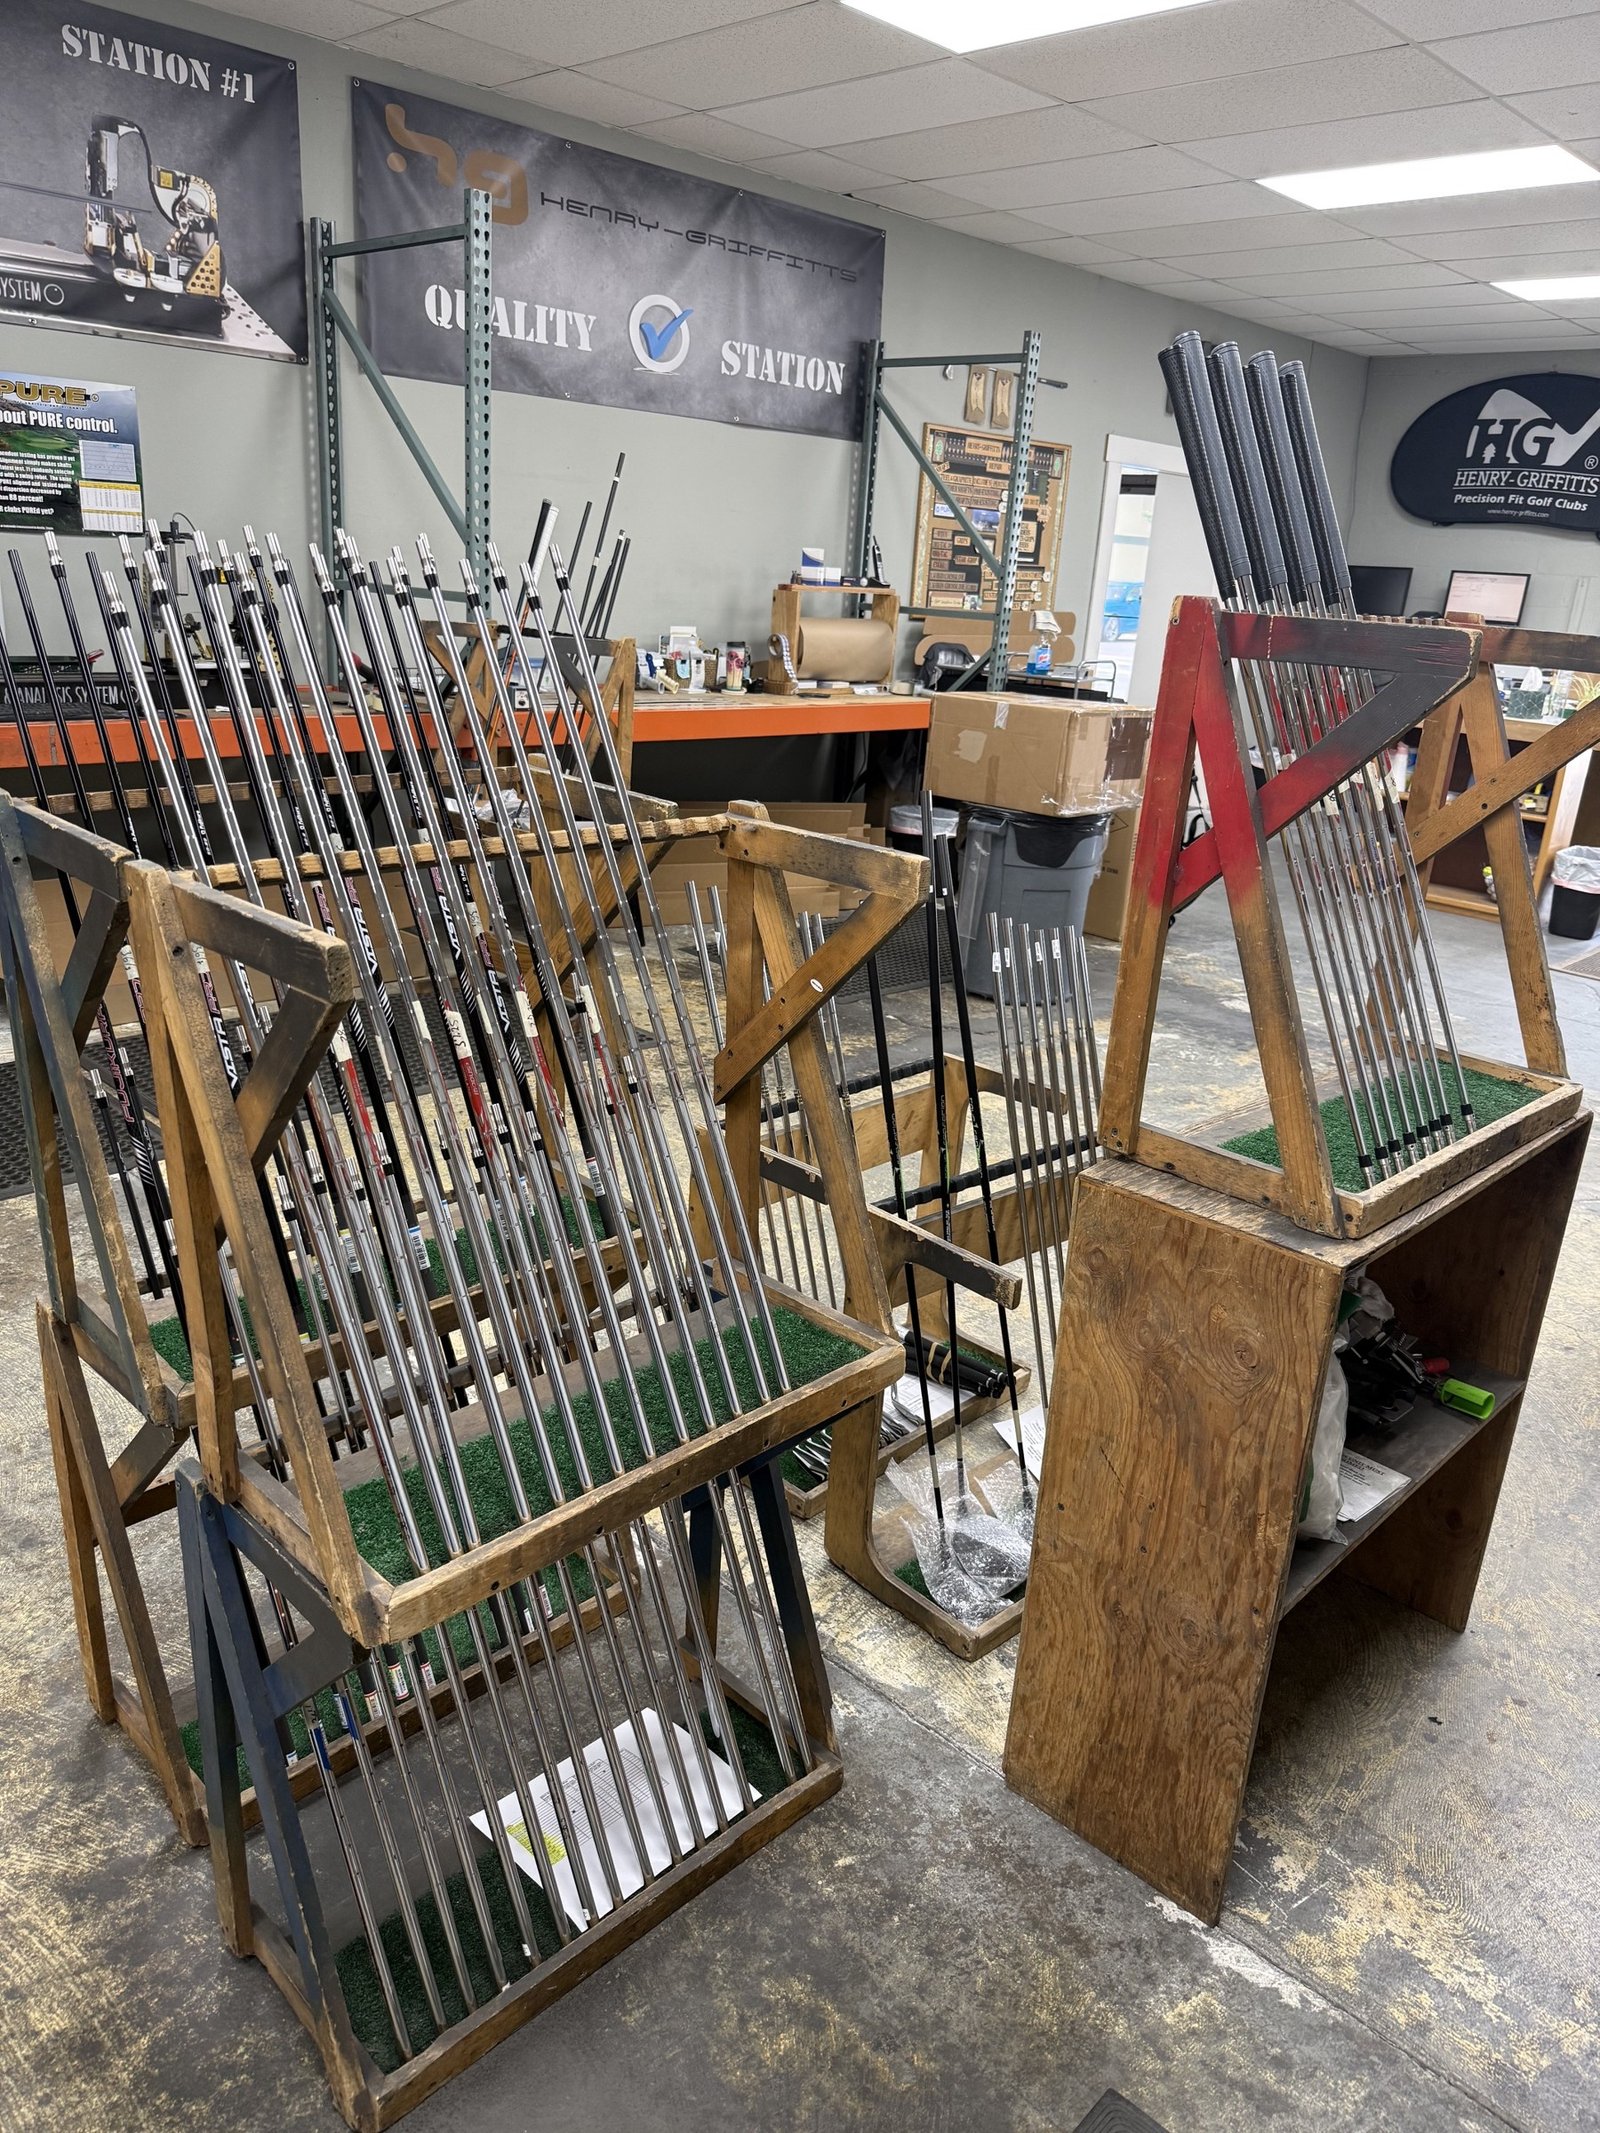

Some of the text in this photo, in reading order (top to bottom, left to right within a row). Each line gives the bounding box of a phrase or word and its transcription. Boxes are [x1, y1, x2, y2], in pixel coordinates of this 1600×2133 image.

[61, 24, 256, 103] STATION #1
[720, 340, 847, 395] STATION
[29, 410, 64, 429] PURE
[66, 416, 118, 434] control.
[1454, 471, 1599, 494] HENRY-GRIFFITTS
[1454, 494, 1588, 512] Precision Fit Golf Clubs
[18, 686, 73, 704] ANALSIS
[75, 686, 119, 705] SYTEM
[353, 907, 378, 975] VISTA
[439, 895, 461, 960] VISTA
[487, 969, 511, 1033] VISTA
[213, 1017, 239, 1089] VISTA
